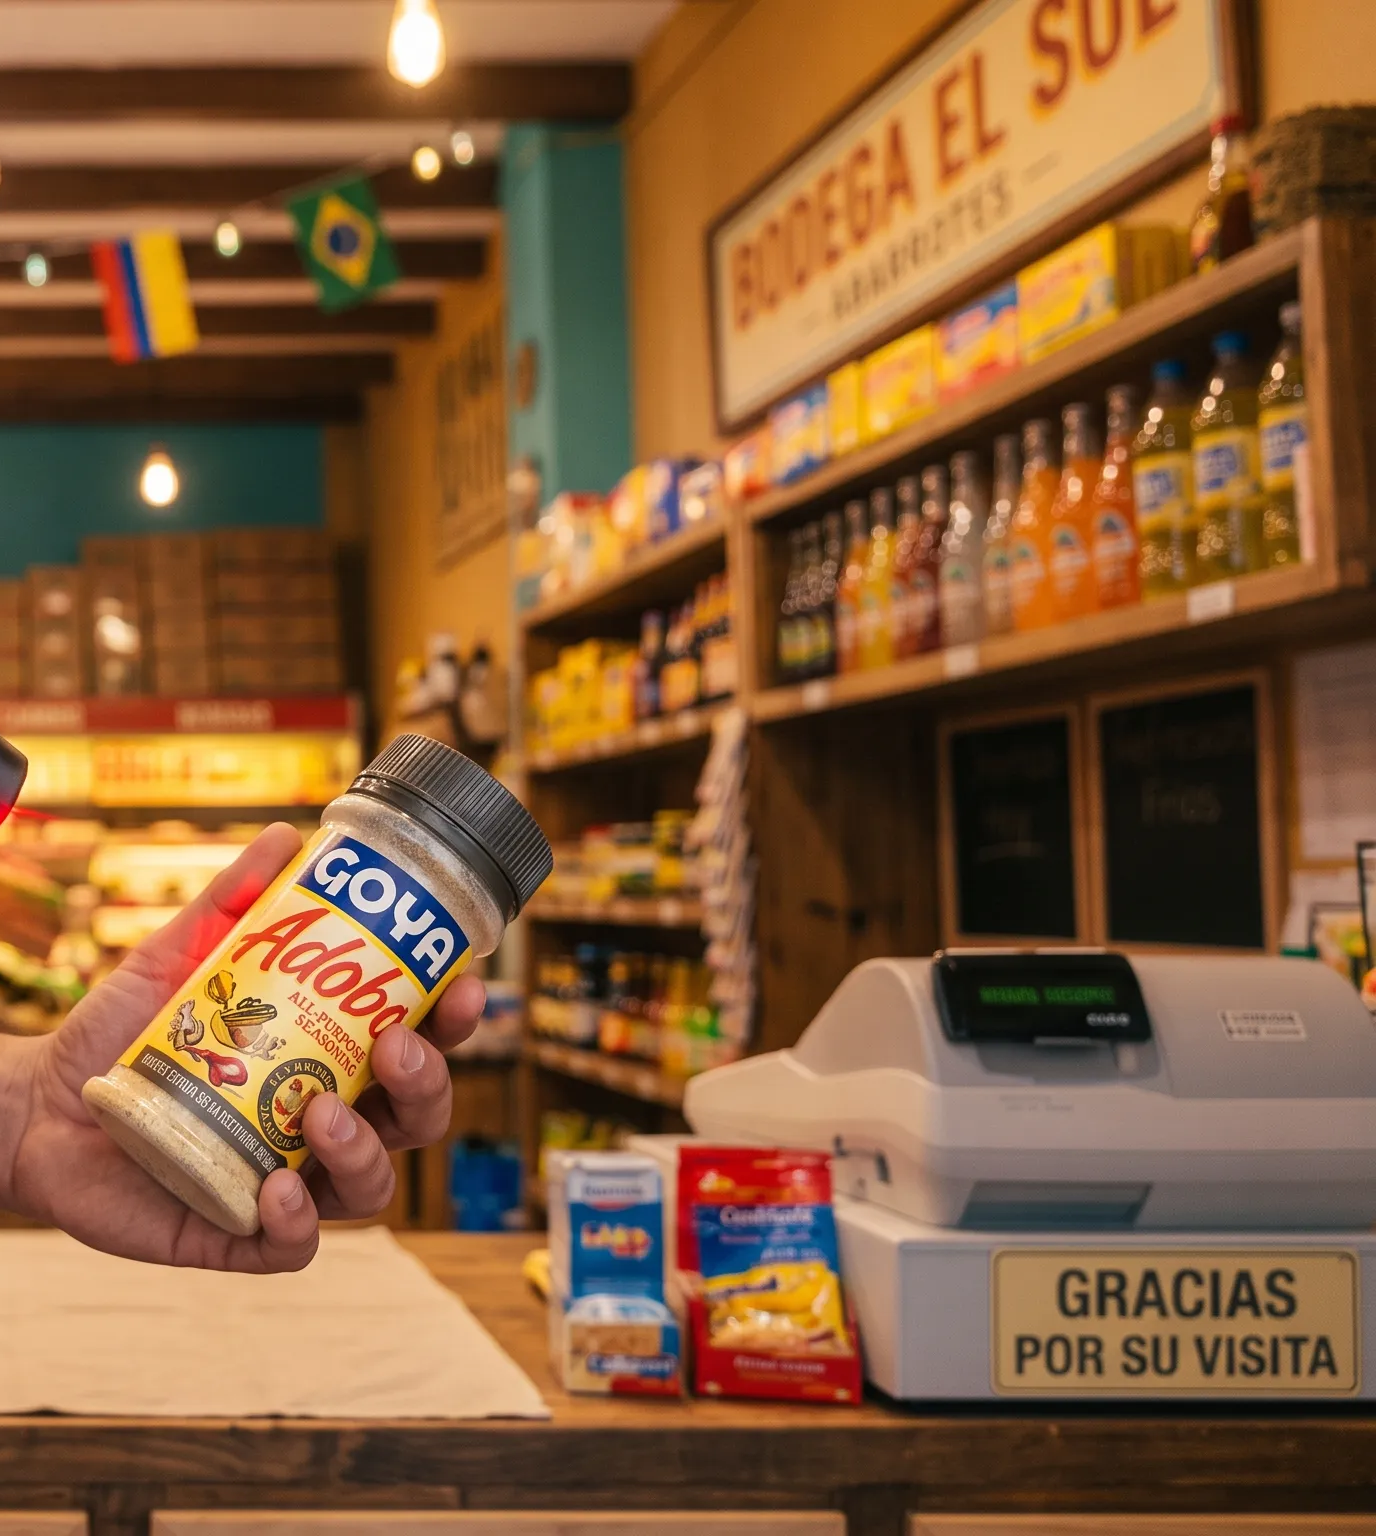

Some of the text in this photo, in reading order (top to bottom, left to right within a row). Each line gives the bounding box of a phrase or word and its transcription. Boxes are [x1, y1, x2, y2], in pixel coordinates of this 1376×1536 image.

[732, 117, 917, 332] BODEGA
[931, 50, 1007, 188] EL
[314, 847, 455, 979] GOYA
[287, 991, 367, 1064] ALL-PURPOSE
[294, 1014, 357, 1077] SEASONING
[1056, 1267, 1299, 1319] GRACIAS
[1014, 1334, 1338, 1377] POR SU VISITA
